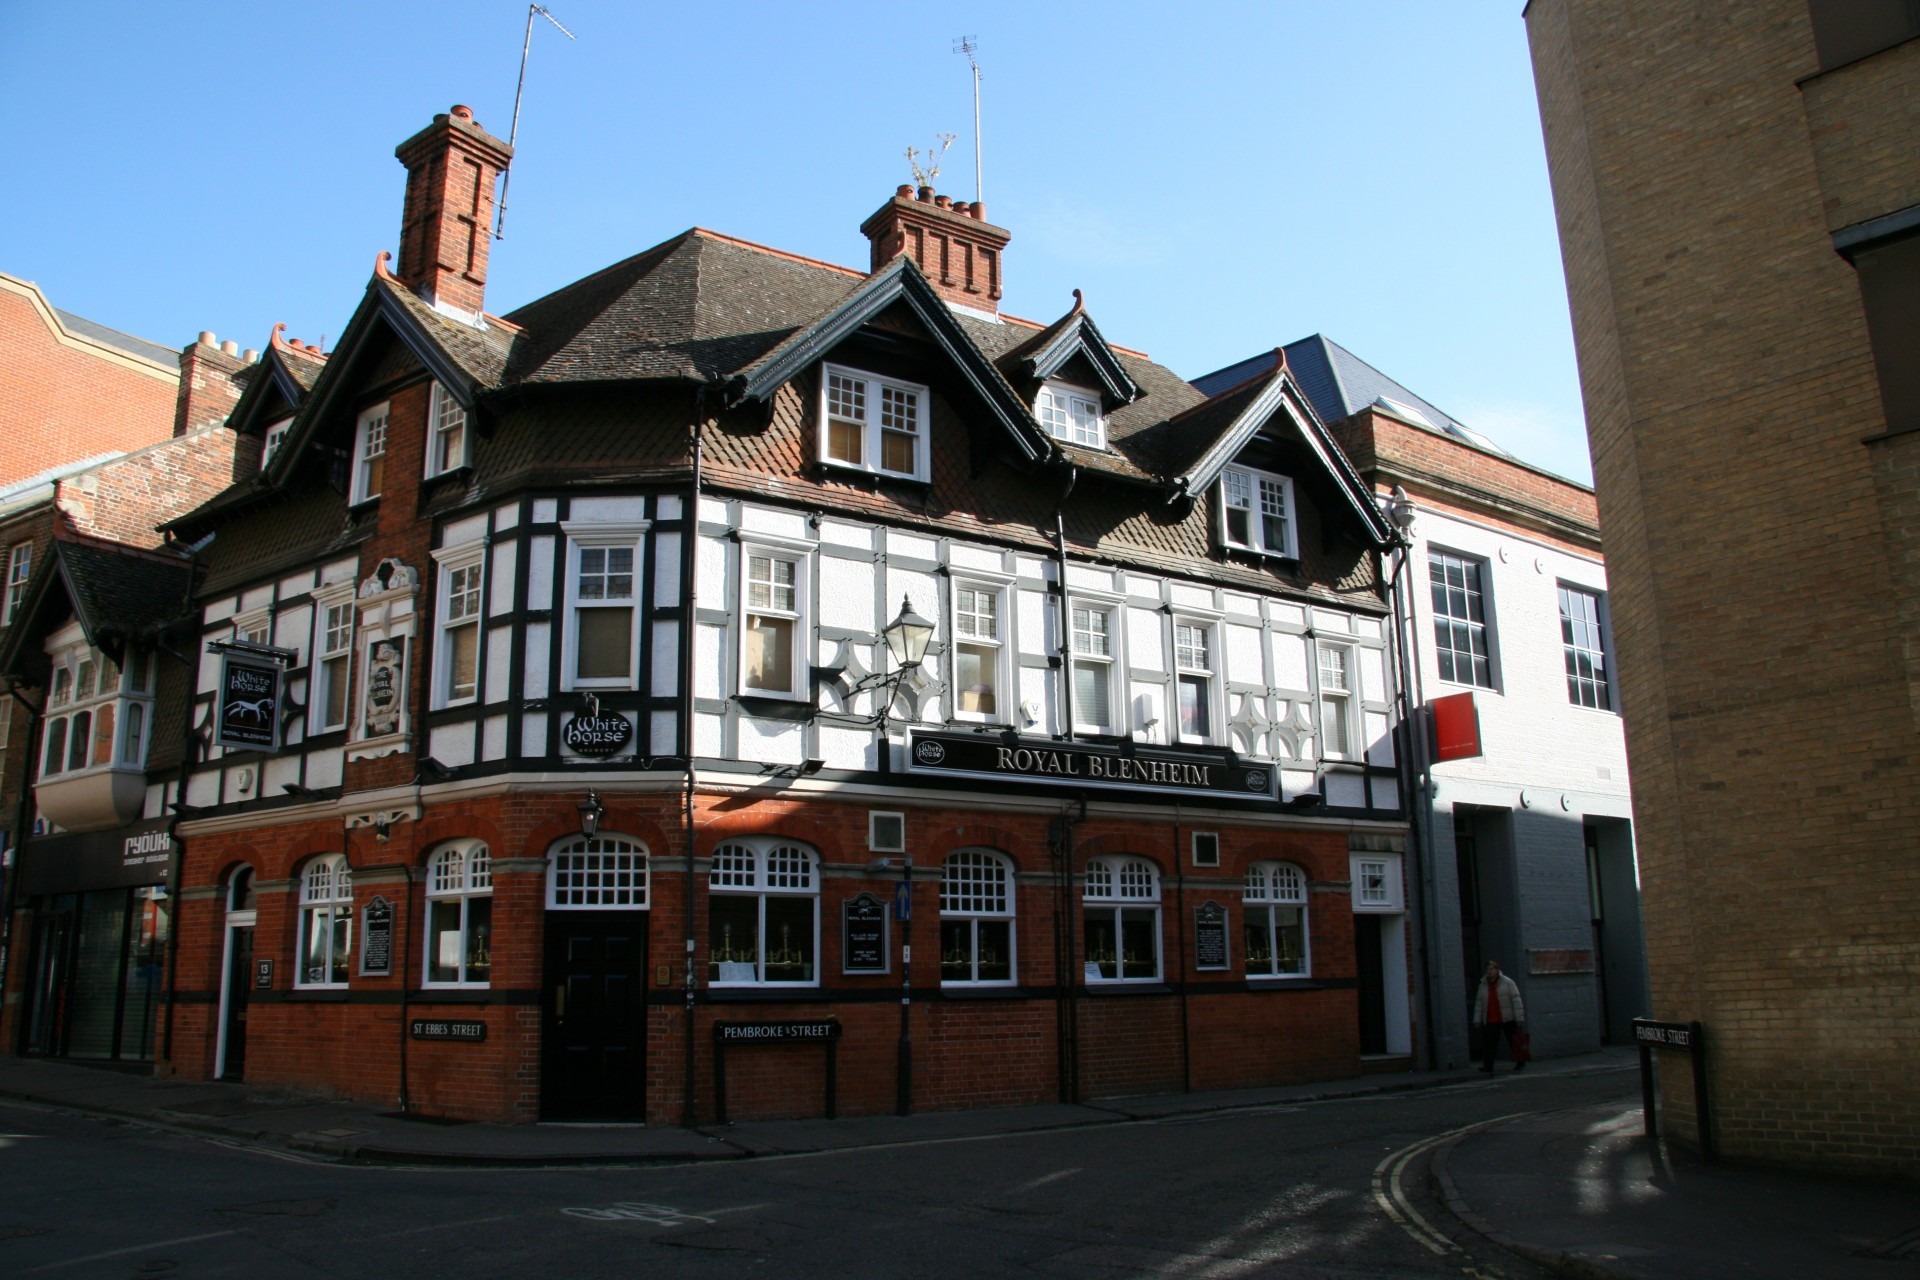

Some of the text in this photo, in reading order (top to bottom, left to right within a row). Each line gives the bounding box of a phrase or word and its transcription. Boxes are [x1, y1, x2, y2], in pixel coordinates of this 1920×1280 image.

[237, 670, 271, 686] White
[577, 716, 630, 732] White
[922, 743, 943, 753] White
[996, 747, 1211, 786] ROYAL BLENHEIM
[260, 964, 269, 974] 13
[413, 1023, 482, 1036] ST EBBES STREET
[724, 1024, 831, 1039] PEMBROKE STREET
[1636, 1026, 1689, 1045] PEMBROKE STREET
